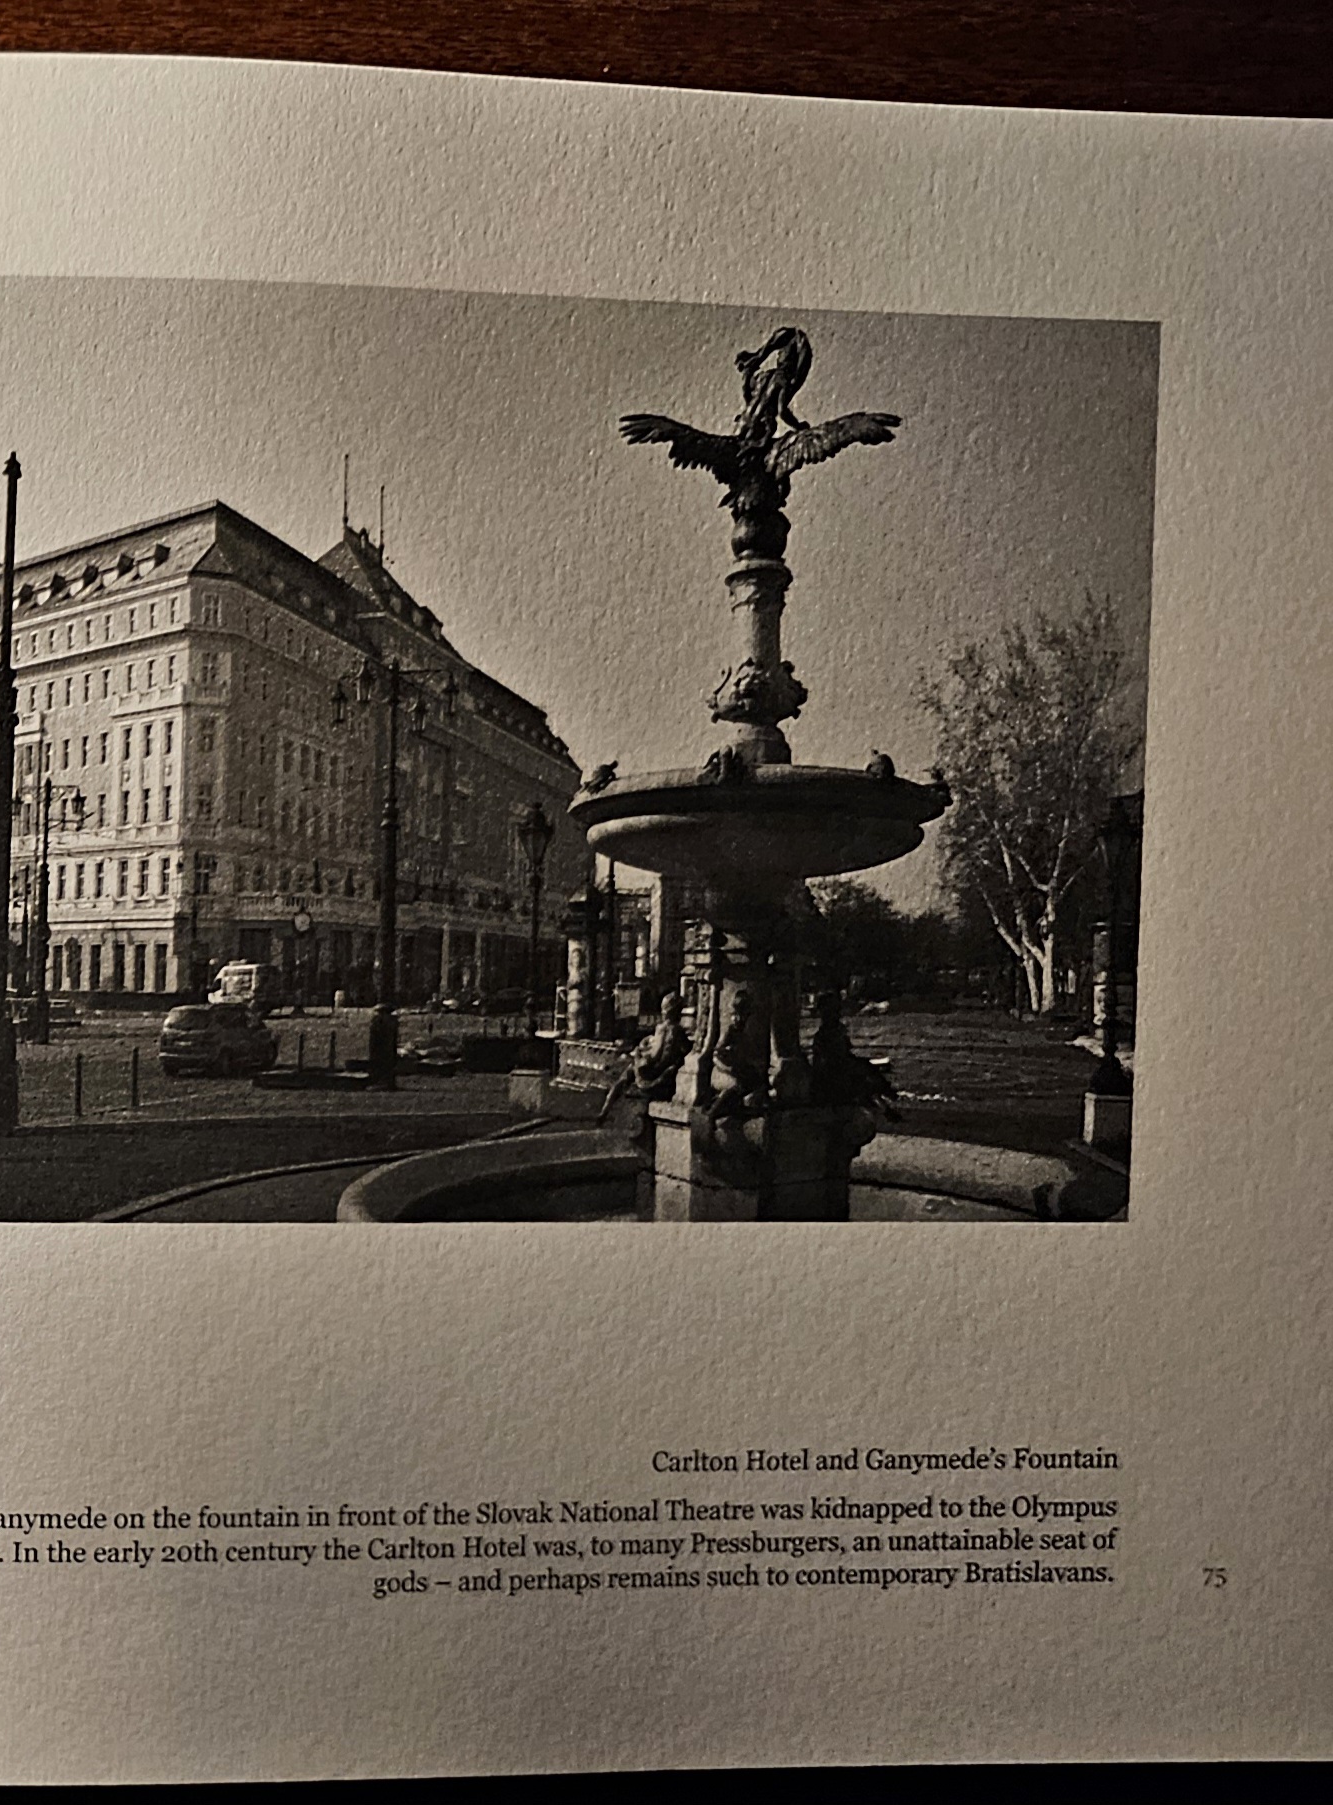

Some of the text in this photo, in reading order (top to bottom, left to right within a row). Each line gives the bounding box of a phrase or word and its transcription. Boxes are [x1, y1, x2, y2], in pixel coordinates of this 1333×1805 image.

[652, 1448, 739, 1473] Carlton
[745, 1447, 810, 1472] Hotel
[815, 1447, 860, 1472] and
[1012, 1446, 1119, 1471] Fountain
[113, 1512, 146, 1530] on
[152, 1505, 192, 1530] the
[198, 1504, 300, 1529] fountain
[306, 1504, 331, 1527] in
[337, 1503, 397, 1527] front
[402, 1501, 429, 1526] of
[432, 1501, 471, 1526] the
[475, 1500, 554, 1525] Slovak
[559, 1498, 659, 1524] National
[664, 1497, 755, 1522] Theatre
[760, 1503, 805, 1521] was
[810, 1495, 934, 1525] kidnapped
[938, 1498, 964, 1519] to
[968, 1494, 1007, 1518] the
[1011, 1493, 1118, 1523] Olympus
[12, 1541, 40, 1563] In
[46, 1539, 87, 1564] the
[93, 1539, 155, 1569] early
[160, 1539, 219, 1563] 20th
[225, 1541, 317, 1567] century
[322, 1537, 361, 1561] the
[367, 1535, 456, 1561] Carlton
[462, 1533, 527, 1559] Hotel
[532, 1540, 584, 1560] was,
[590, 1536, 615, 1557] to
[619, 1538, 686, 1561] many
[690, 1529, 848, 1559] Pressburgers,
[852, 1535, 884, 1553] an
[887, 1526, 1035, 1552] unattainable
[1039, 1530, 1088, 1551] seat
[1092, 1526, 1120, 1551] of
[372, 1569, 430, 1600] gods
[457, 1567, 503, 1593] and
[508, 1566, 602, 1597] perhaps
[607, 1565, 701, 1589] remains
[706, 1562, 760, 1589] such
[765, 1566, 790, 1587] to
[795, 1565, 960, 1591] contemporary
[963, 1559, 1115, 1584] Bratislavans.
[1202, 1567, 1227, 1589] 75
